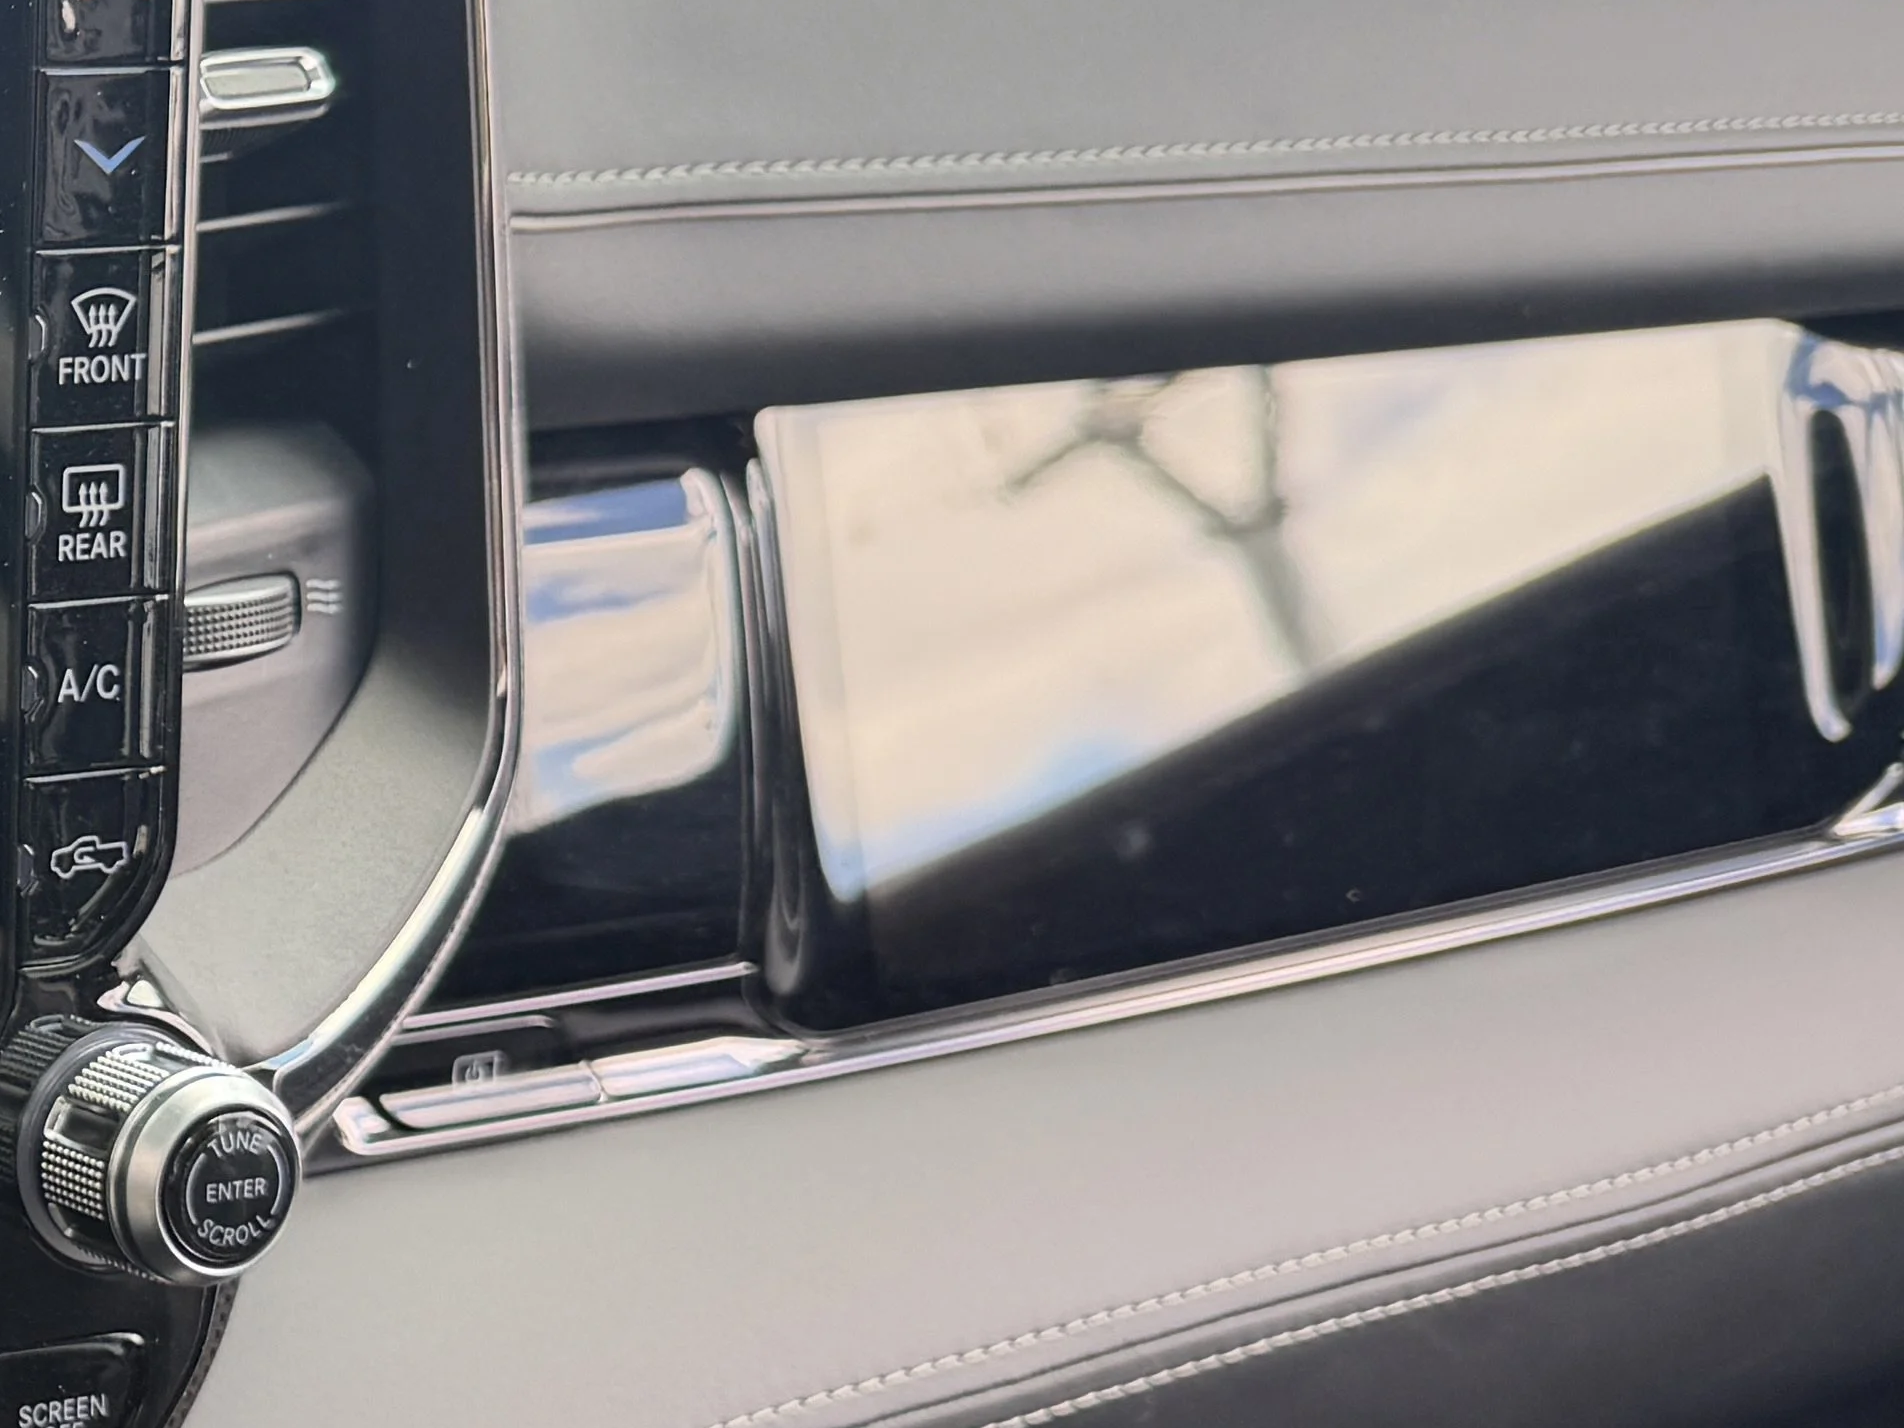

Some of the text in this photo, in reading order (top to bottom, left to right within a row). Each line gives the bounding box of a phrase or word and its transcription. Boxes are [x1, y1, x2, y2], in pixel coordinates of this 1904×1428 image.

[58, 351, 146, 385] FRONT
[58, 533, 127, 563] REAR
[58, 665, 120, 704] A/C
[207, 1130, 264, 1160] TUNE
[205, 1178, 267, 1204] ENTER
[197, 1215, 274, 1248] SCROLL
